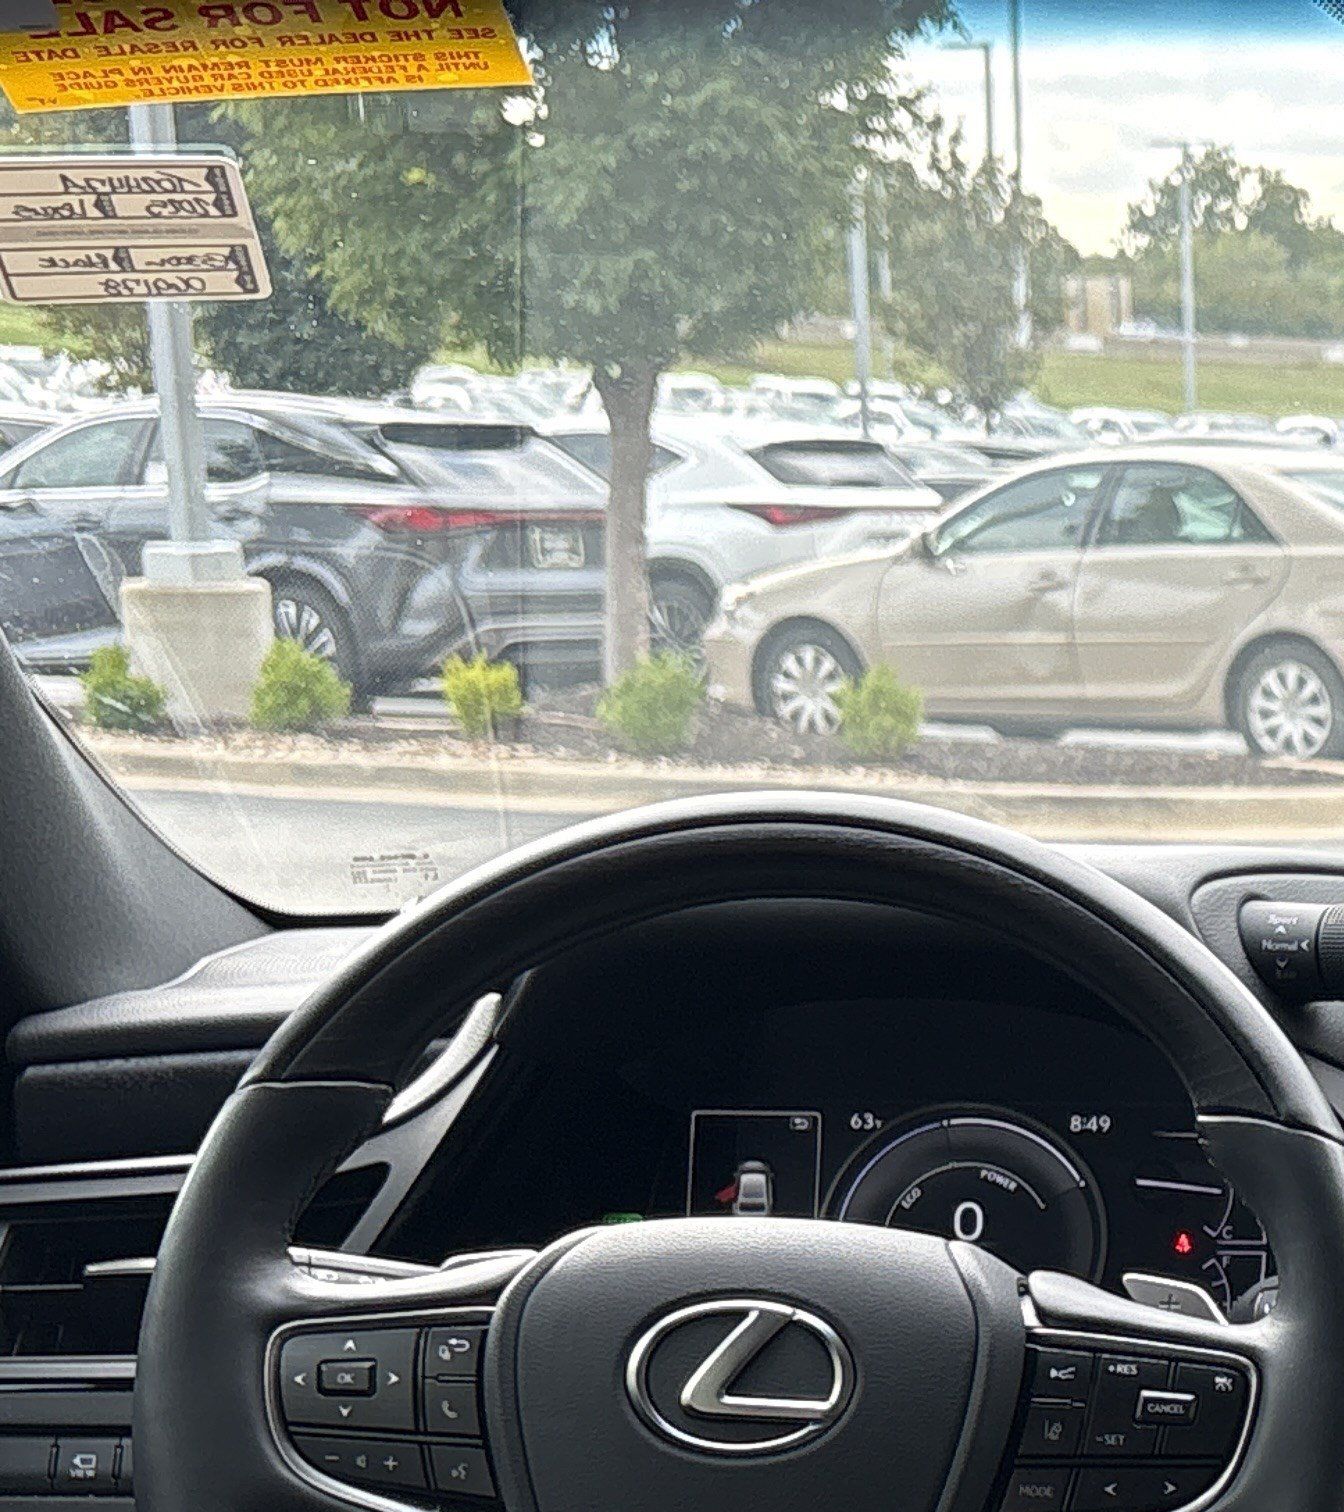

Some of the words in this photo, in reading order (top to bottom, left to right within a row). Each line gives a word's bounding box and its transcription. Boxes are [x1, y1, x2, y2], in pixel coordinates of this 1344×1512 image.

[1069, 1114, 1111, 1134] 8:49
[979, 1168, 1019, 1193] POWER
[953, 1200, 984, 1242] 0
[336, 1372, 355, 1385] OK
[1147, 1403, 1187, 1416] CANCEL
[1019, 1485, 1055, 1498] MODE
